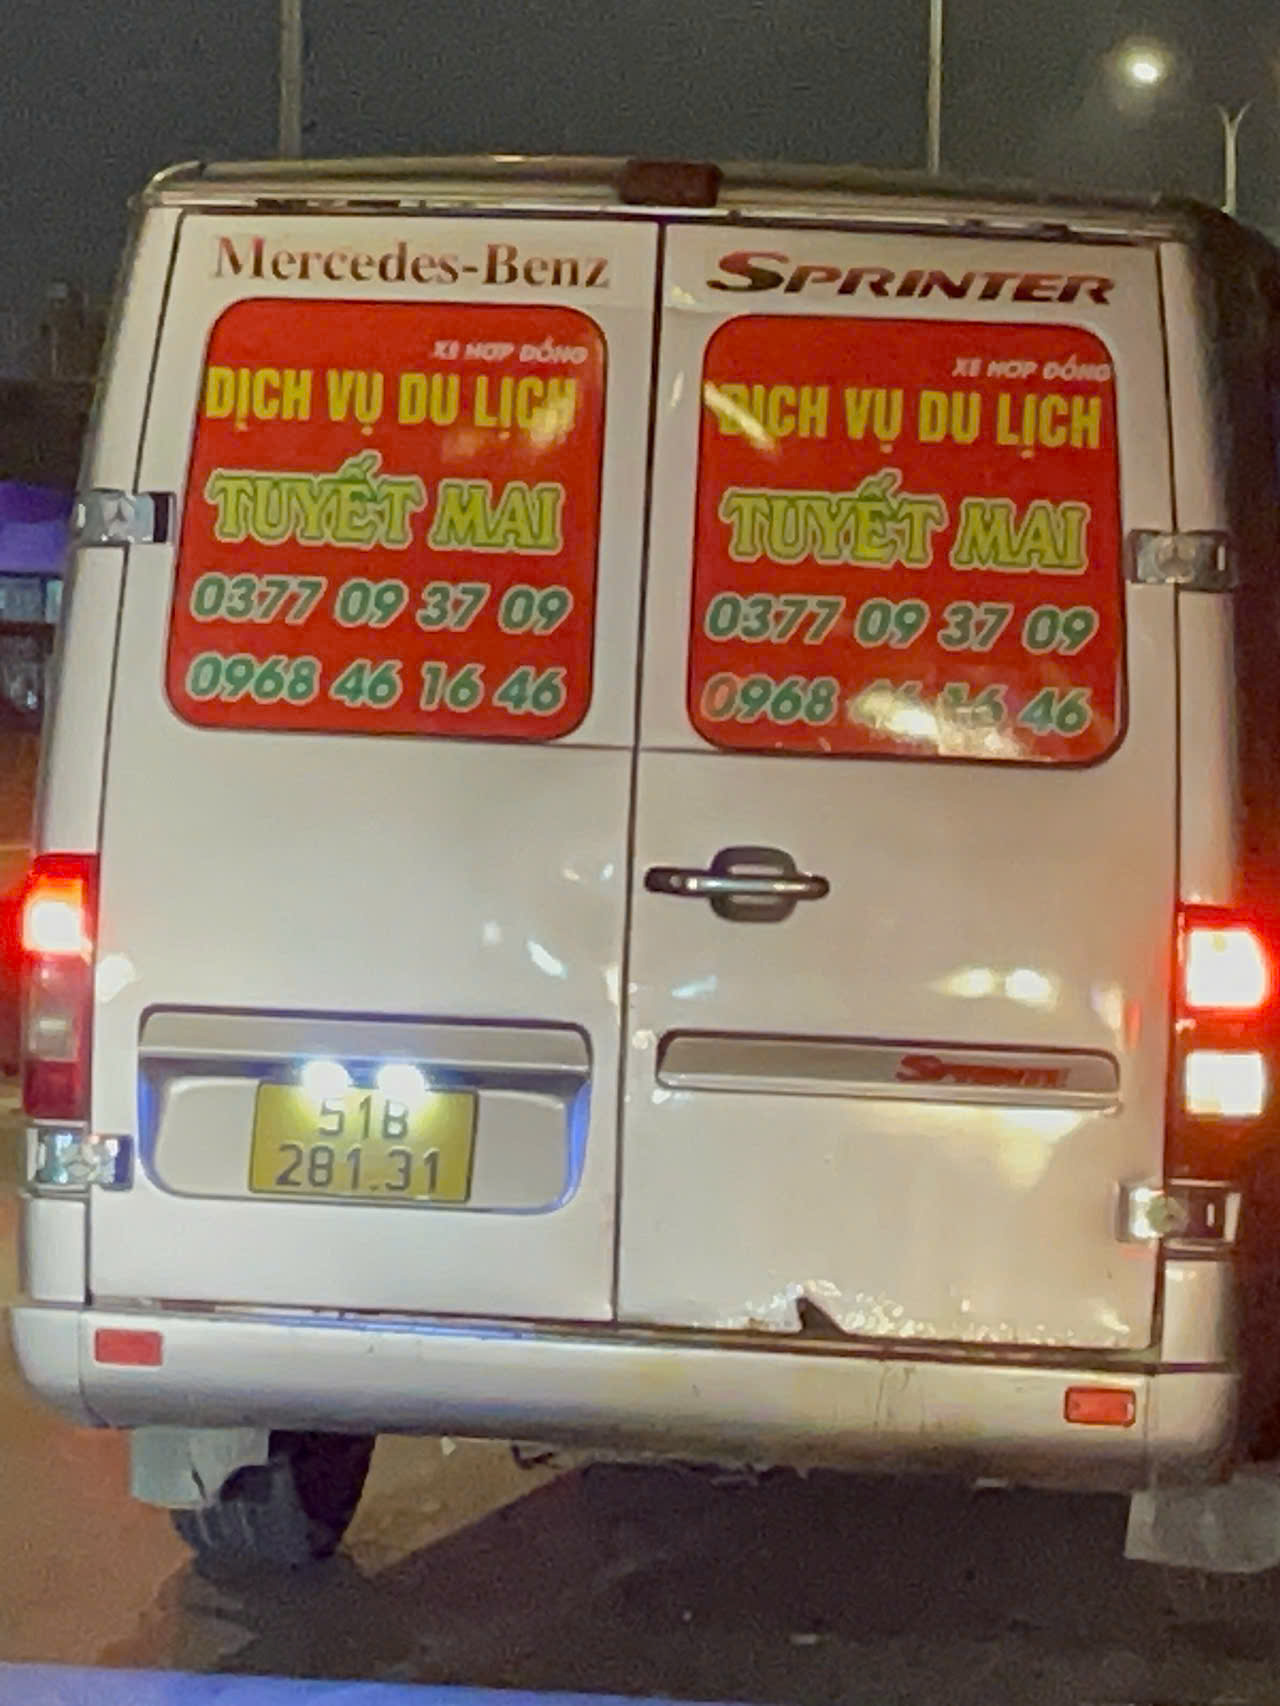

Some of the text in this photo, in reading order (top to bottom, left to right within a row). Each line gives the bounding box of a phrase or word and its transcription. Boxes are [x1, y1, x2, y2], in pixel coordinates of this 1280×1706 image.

[215, 236, 610, 289] Mercedes-Benz
[206, 366, 577, 441] DỊCH VỤ DU LỊCH
[845, 388, 904, 454] VỤ
[918, 390, 980, 445] DU
[996, 393, 1102, 459] LỊCH
[206, 449, 564, 556] TUYẾT MAI
[720, 468, 1092, 576] TUYẾT MAI
[190, 572, 572, 635] 0377 09 37 09
[705, 591, 1100, 656] 0377 09 37 09
[185, 650, 567, 716] 0968 46 16 46
[701, 671, 840, 726] 0968
[1015, 685, 1093, 738] 46
[318, 1095, 409, 1139] 51B
[275, 1142, 442, 1192] 281.31
